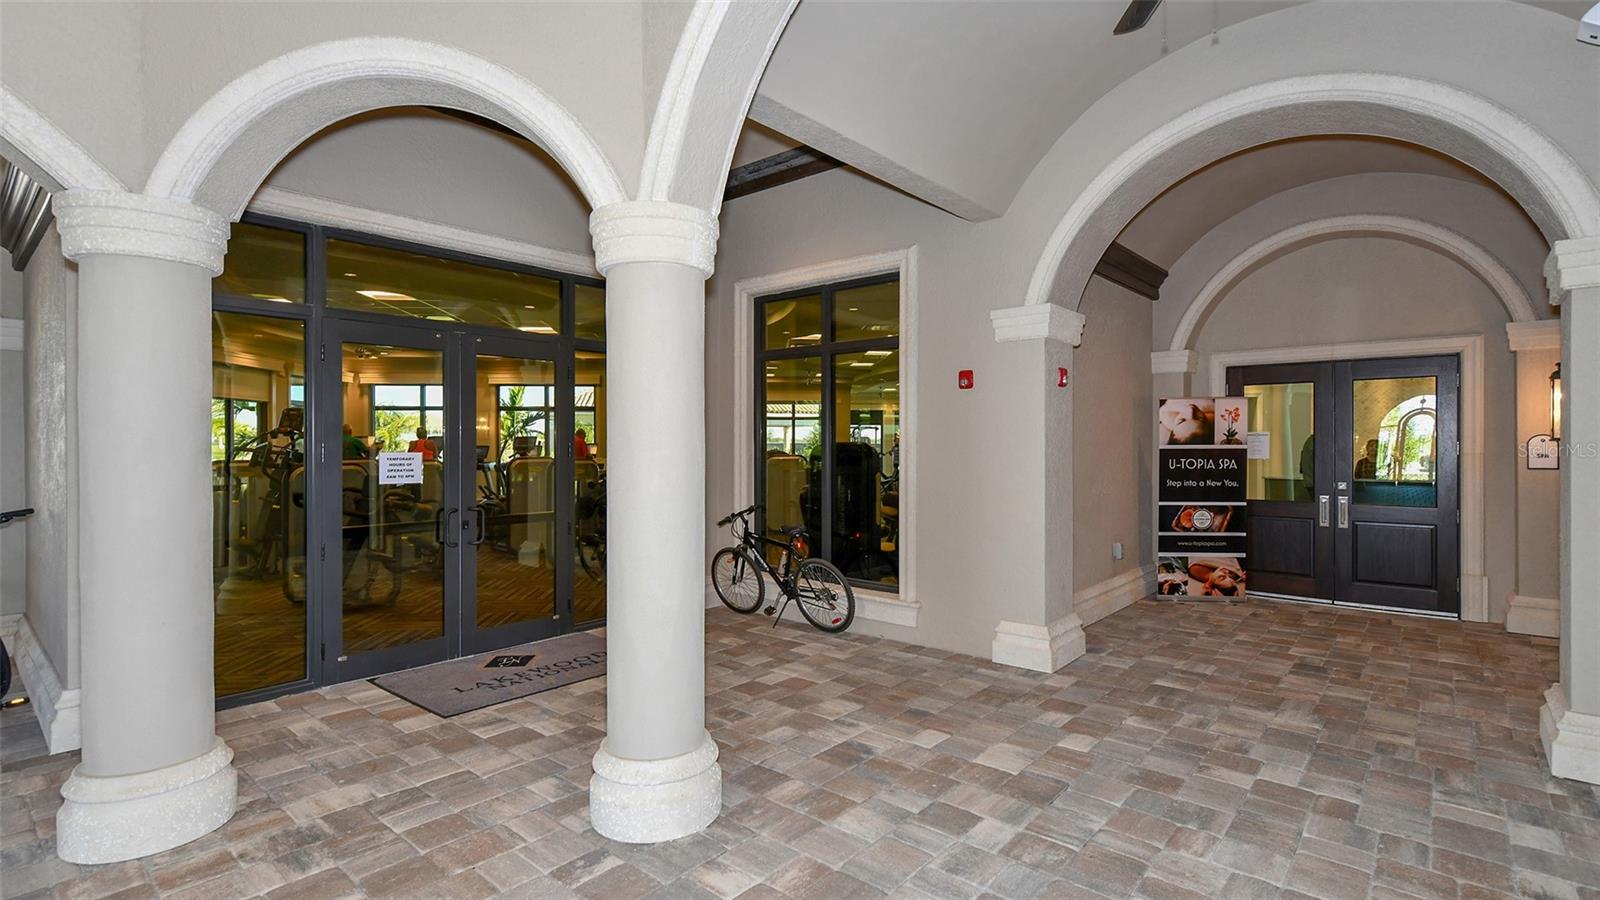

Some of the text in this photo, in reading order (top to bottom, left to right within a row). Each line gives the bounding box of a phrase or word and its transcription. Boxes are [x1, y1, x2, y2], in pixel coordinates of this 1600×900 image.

[1168, 458, 1238, 470] U-TOPIA SPA
[1166, 479, 1181, 489] Step
[1183, 479, 1198, 487] into
[1206, 479, 1223, 487] New
[1223, 479, 1240, 487] You.
[453, 651, 607, 693] LAKEWOOD
[488, 659, 605, 690] NATIONAL
